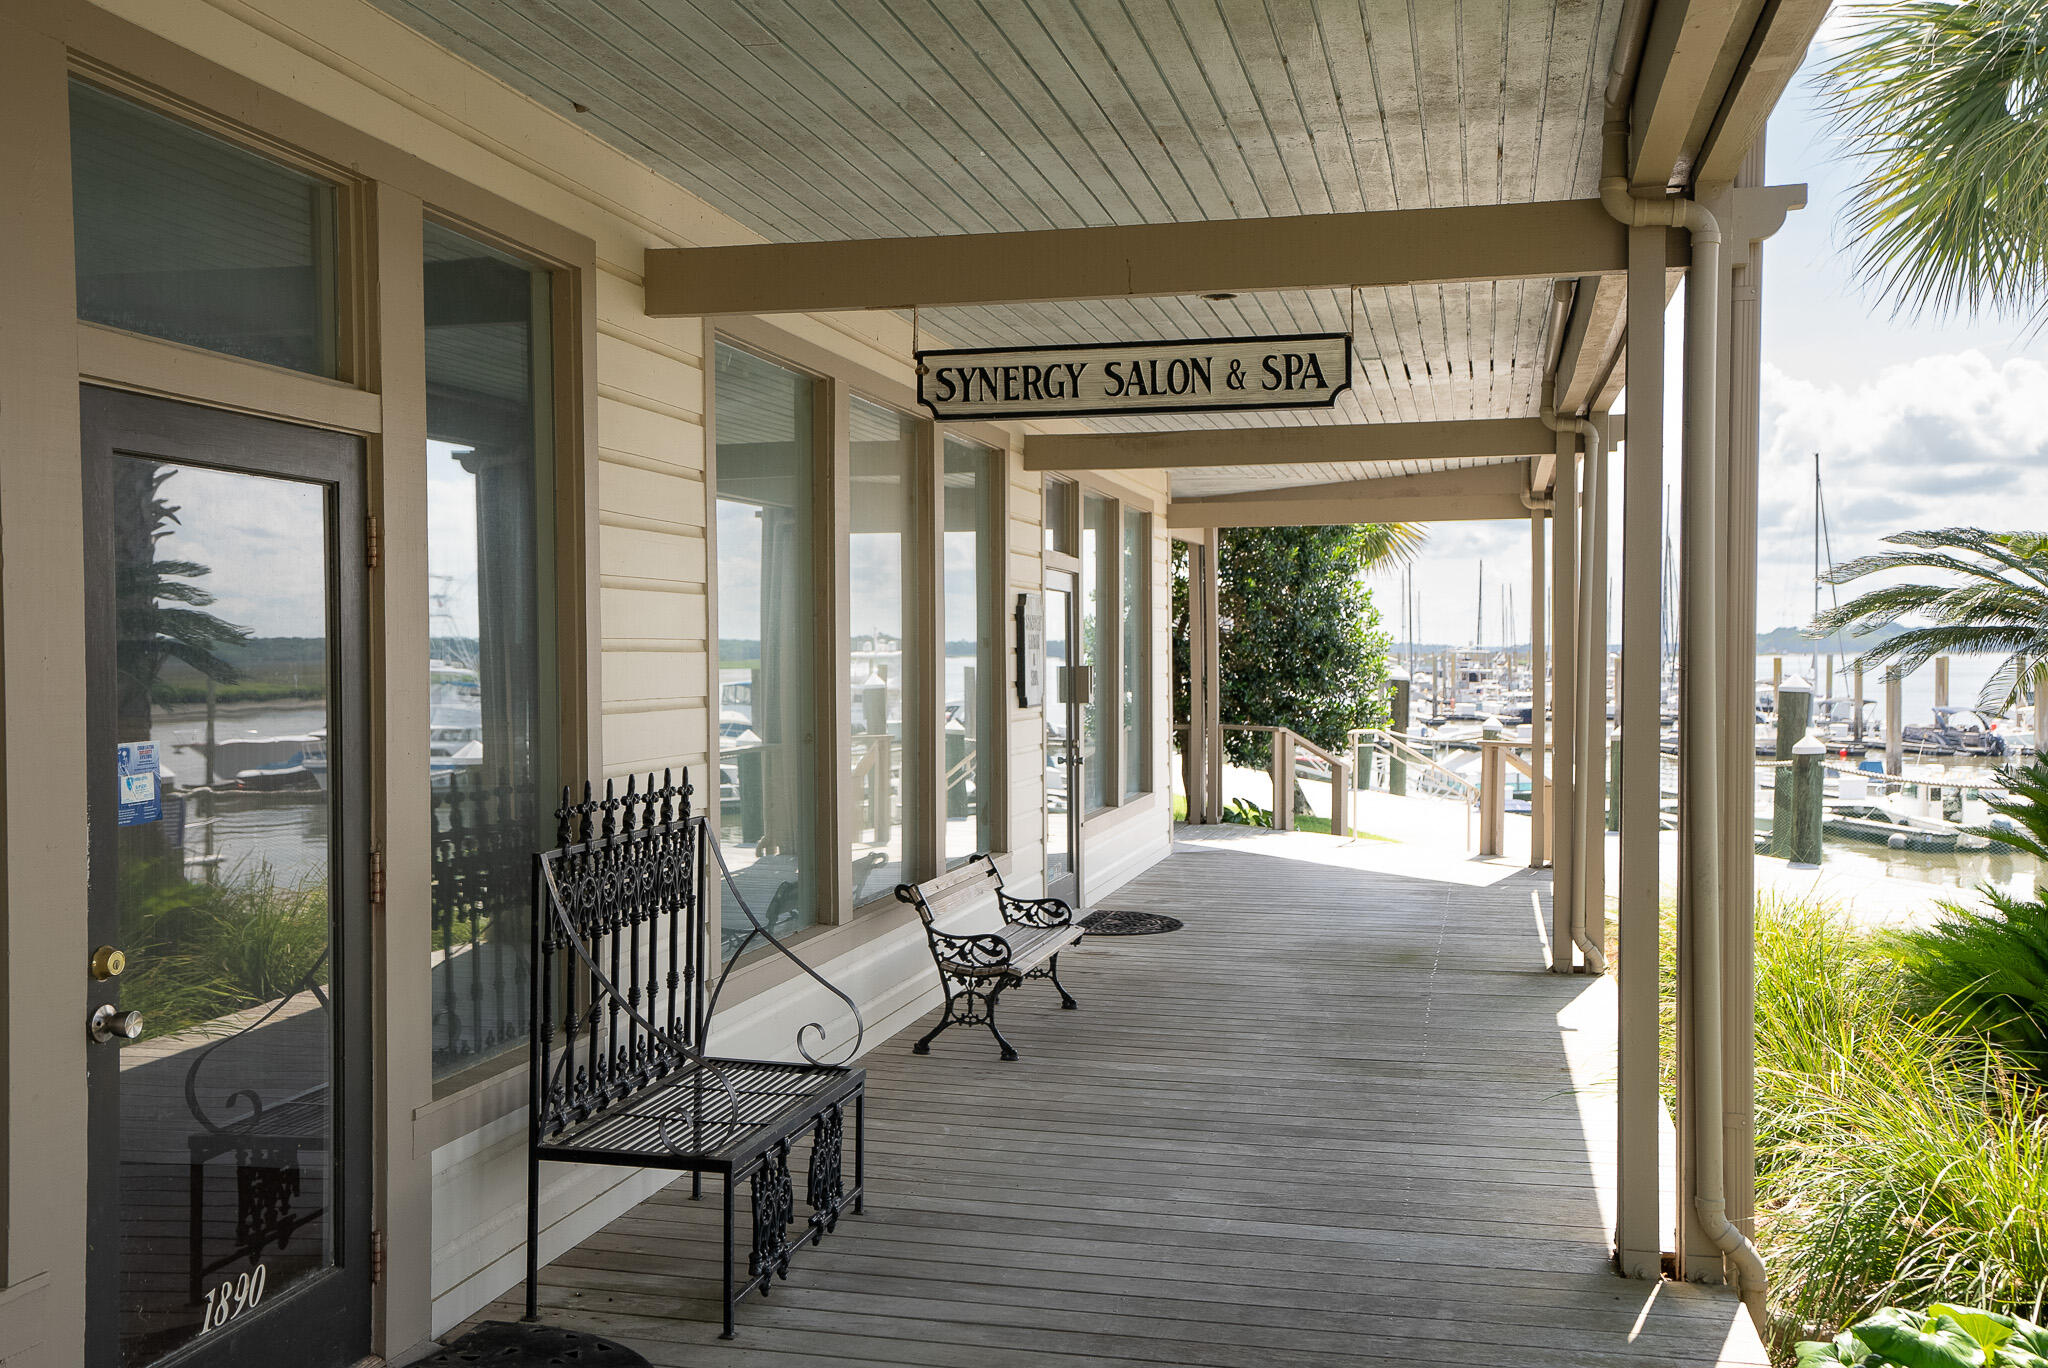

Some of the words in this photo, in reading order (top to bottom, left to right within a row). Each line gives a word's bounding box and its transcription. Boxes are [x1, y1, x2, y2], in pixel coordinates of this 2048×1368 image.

[935, 362, 1089, 403] SYNERGY
[1104, 356, 1213, 397] SALON
[1226, 358, 1247, 391] &
[1261, 352, 1329, 391] SPA
[199, 1264, 266, 1335] 1890
